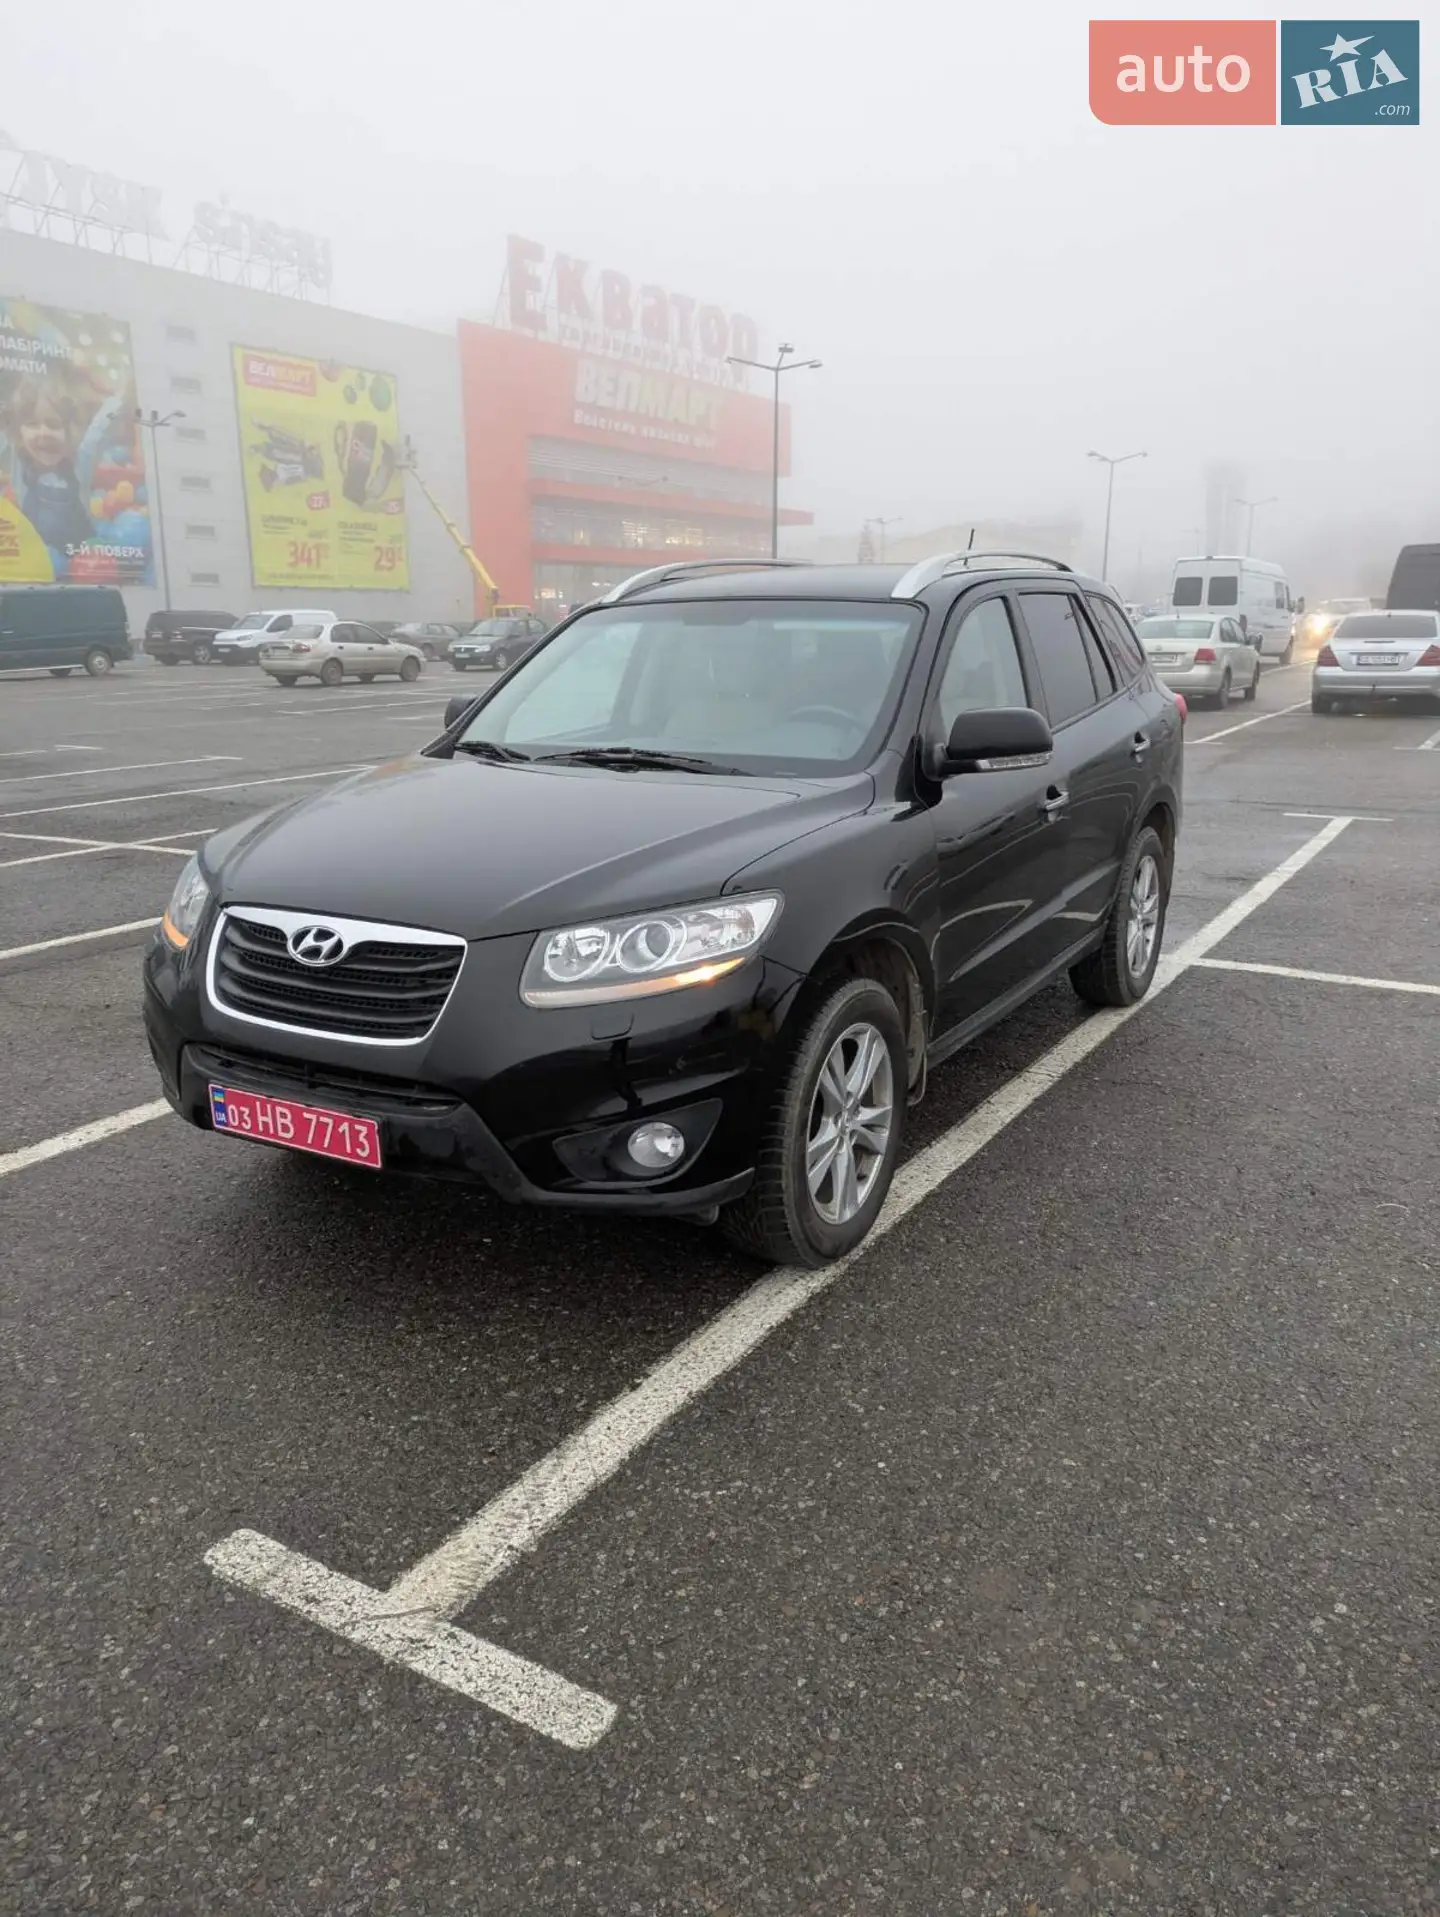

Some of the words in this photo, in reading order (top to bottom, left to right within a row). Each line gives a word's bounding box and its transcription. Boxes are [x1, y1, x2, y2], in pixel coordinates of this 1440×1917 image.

[65, 541, 90, 556] 3-Й
[94, 544, 145, 558] ПОВЕРХ
[215, 1112, 227, 1123] UA
[228, 1104, 252, 1130] 03
[302, 1112, 371, 1158] 7713
